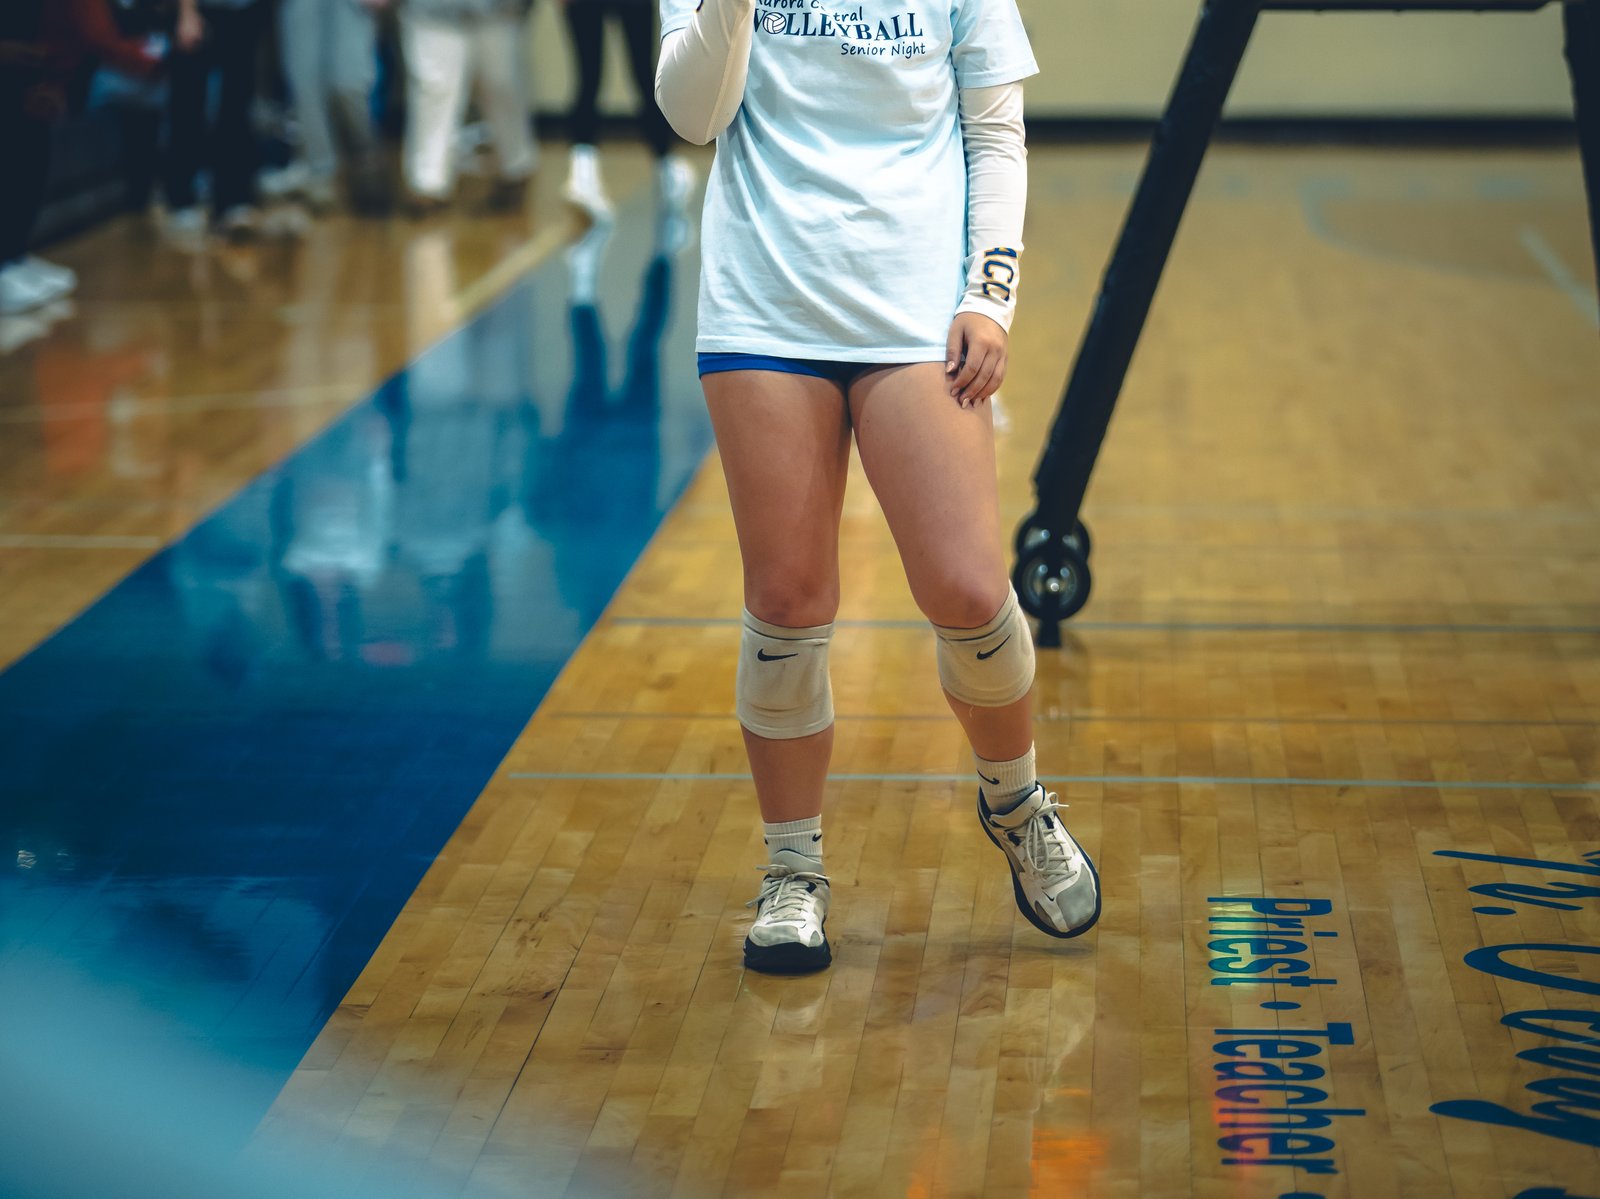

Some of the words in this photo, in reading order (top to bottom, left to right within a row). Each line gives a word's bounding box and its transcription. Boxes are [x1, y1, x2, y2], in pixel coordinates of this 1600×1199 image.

[840, 42, 886, 56] Senior
[891, 41, 926, 59] Night
[1207, 897, 1339, 986] Priest
[1212, 1022, 1366, 1175] Teacher
